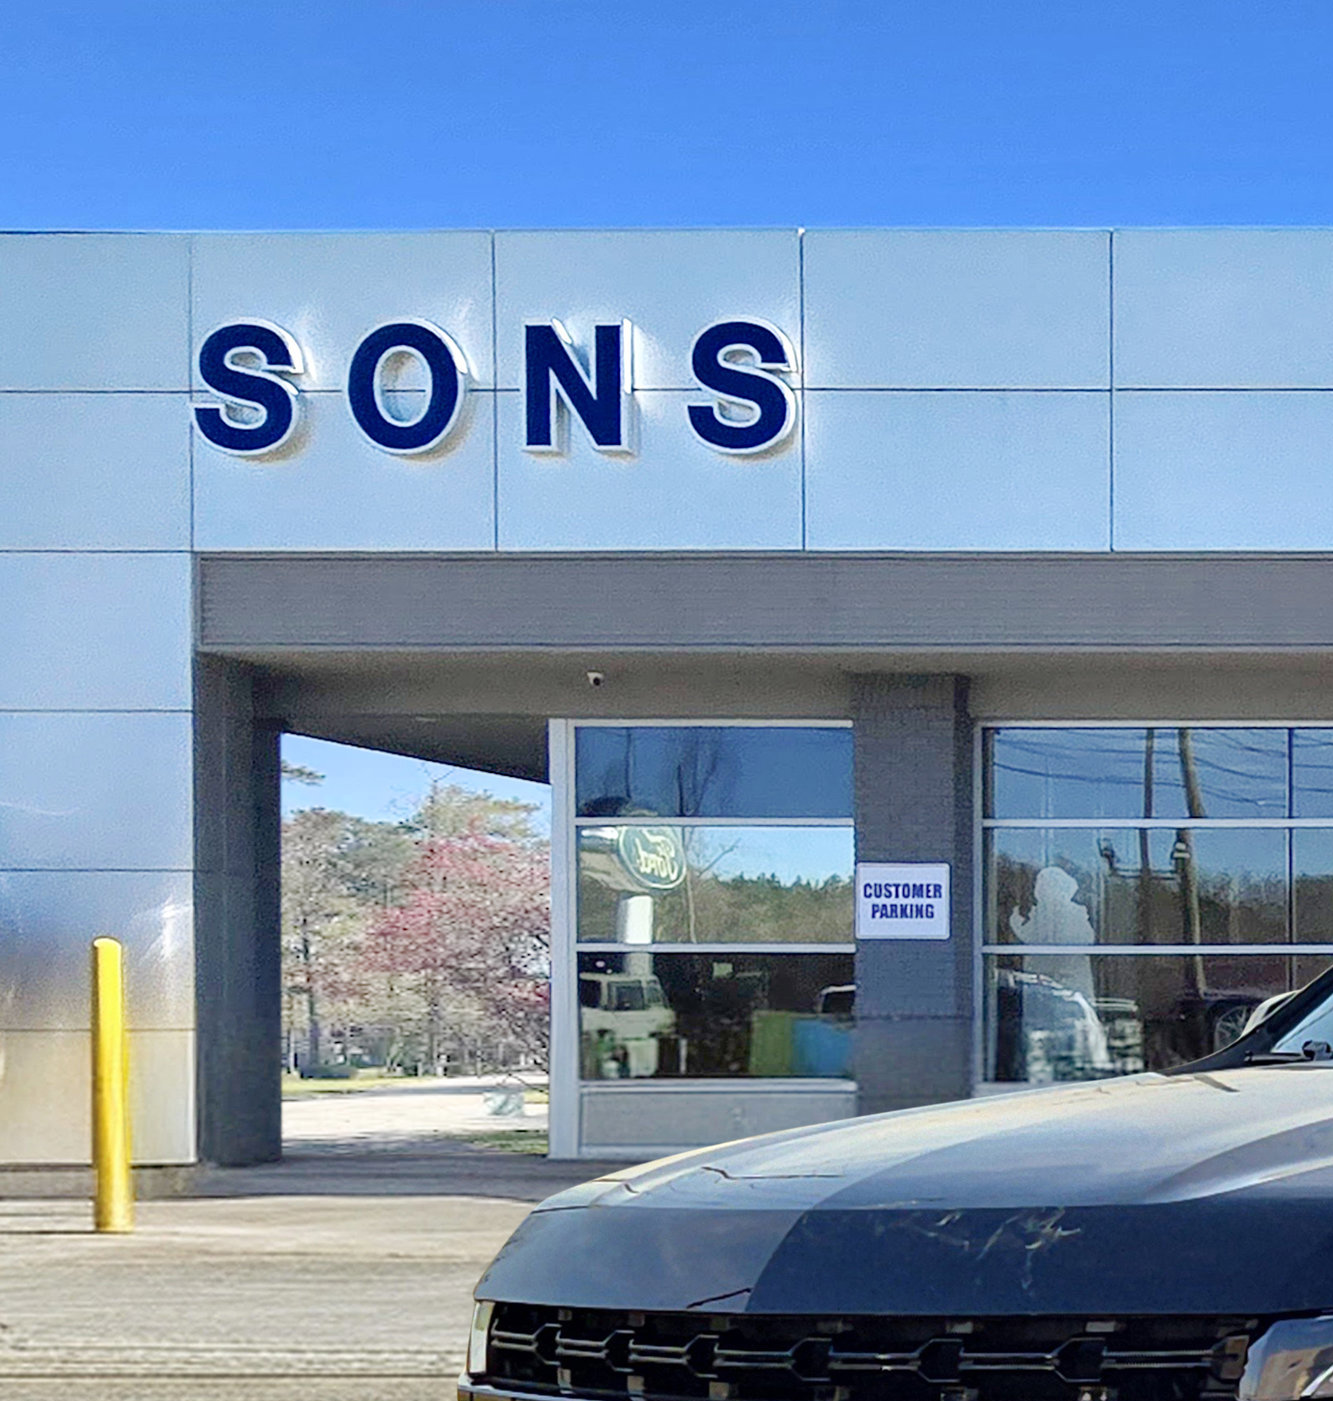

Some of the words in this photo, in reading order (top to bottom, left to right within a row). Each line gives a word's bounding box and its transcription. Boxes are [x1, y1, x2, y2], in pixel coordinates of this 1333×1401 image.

[193, 320, 798, 454] SONS
[863, 882, 943, 900] CUSTOMER
[870, 903, 936, 921] PARKING
